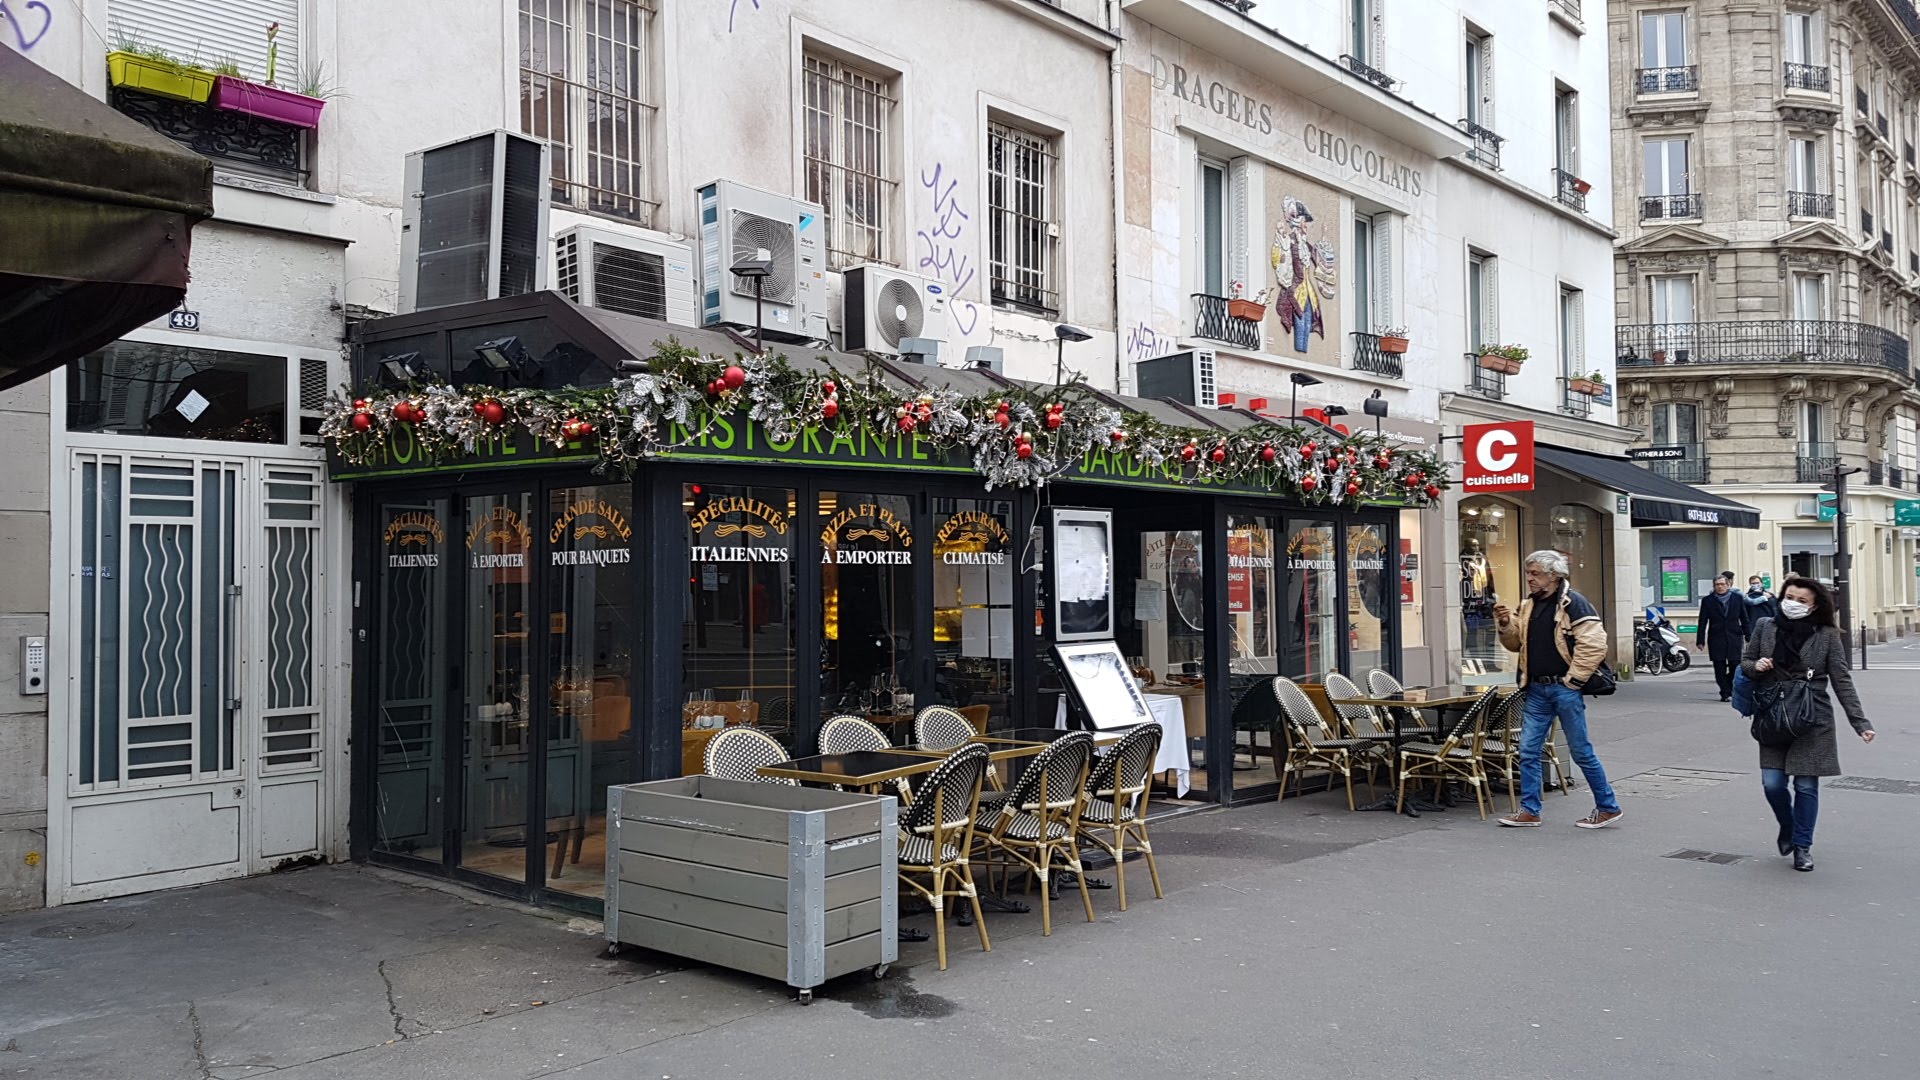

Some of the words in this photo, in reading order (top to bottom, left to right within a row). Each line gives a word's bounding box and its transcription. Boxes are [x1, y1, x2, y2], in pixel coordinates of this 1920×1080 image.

[1151, 54, 1272, 135] DRAGEES
[1303, 123, 1421, 197] CHOCOLATS
[173, 313, 196, 328] 49
[1476, 429, 1518, 472] C
[1665, 449, 1683, 457] SONS
[1465, 473, 1529, 486] cuisinella
[492, 506, 505, 521] ET
[549, 499, 596, 544] GRANDE
[597, 501, 633, 543] SALLE
[691, 497, 788, 535] SPÉCIALITÉS
[384, 511, 446, 546] SPÉCIALITÉS
[820, 506, 858, 544] PIZZA
[859, 503, 877, 517] ET
[878, 508, 913, 547] PLATS
[936, 510, 1010, 544] RESTAURANT
[389, 554, 439, 568] ITALIENNES
[472, 552, 479, 569] À
[480, 553, 524, 568] EMPORTER
[552, 550, 578, 566] POUR
[579, 548, 630, 568] BANQUETS
[691, 546, 788, 562] ITALIENNES
[821, 546, 833, 564] À
[836, 550, 912, 565] EMPORTER
[943, 549, 1005, 565] CLIMATISÉ
[1287, 556, 1294, 569] À
[1295, 560, 1336, 570] EMPORTER
[1351, 558, 1384, 570] CLIMATISÉ
[1227, 573, 1244, 581] EMISE
